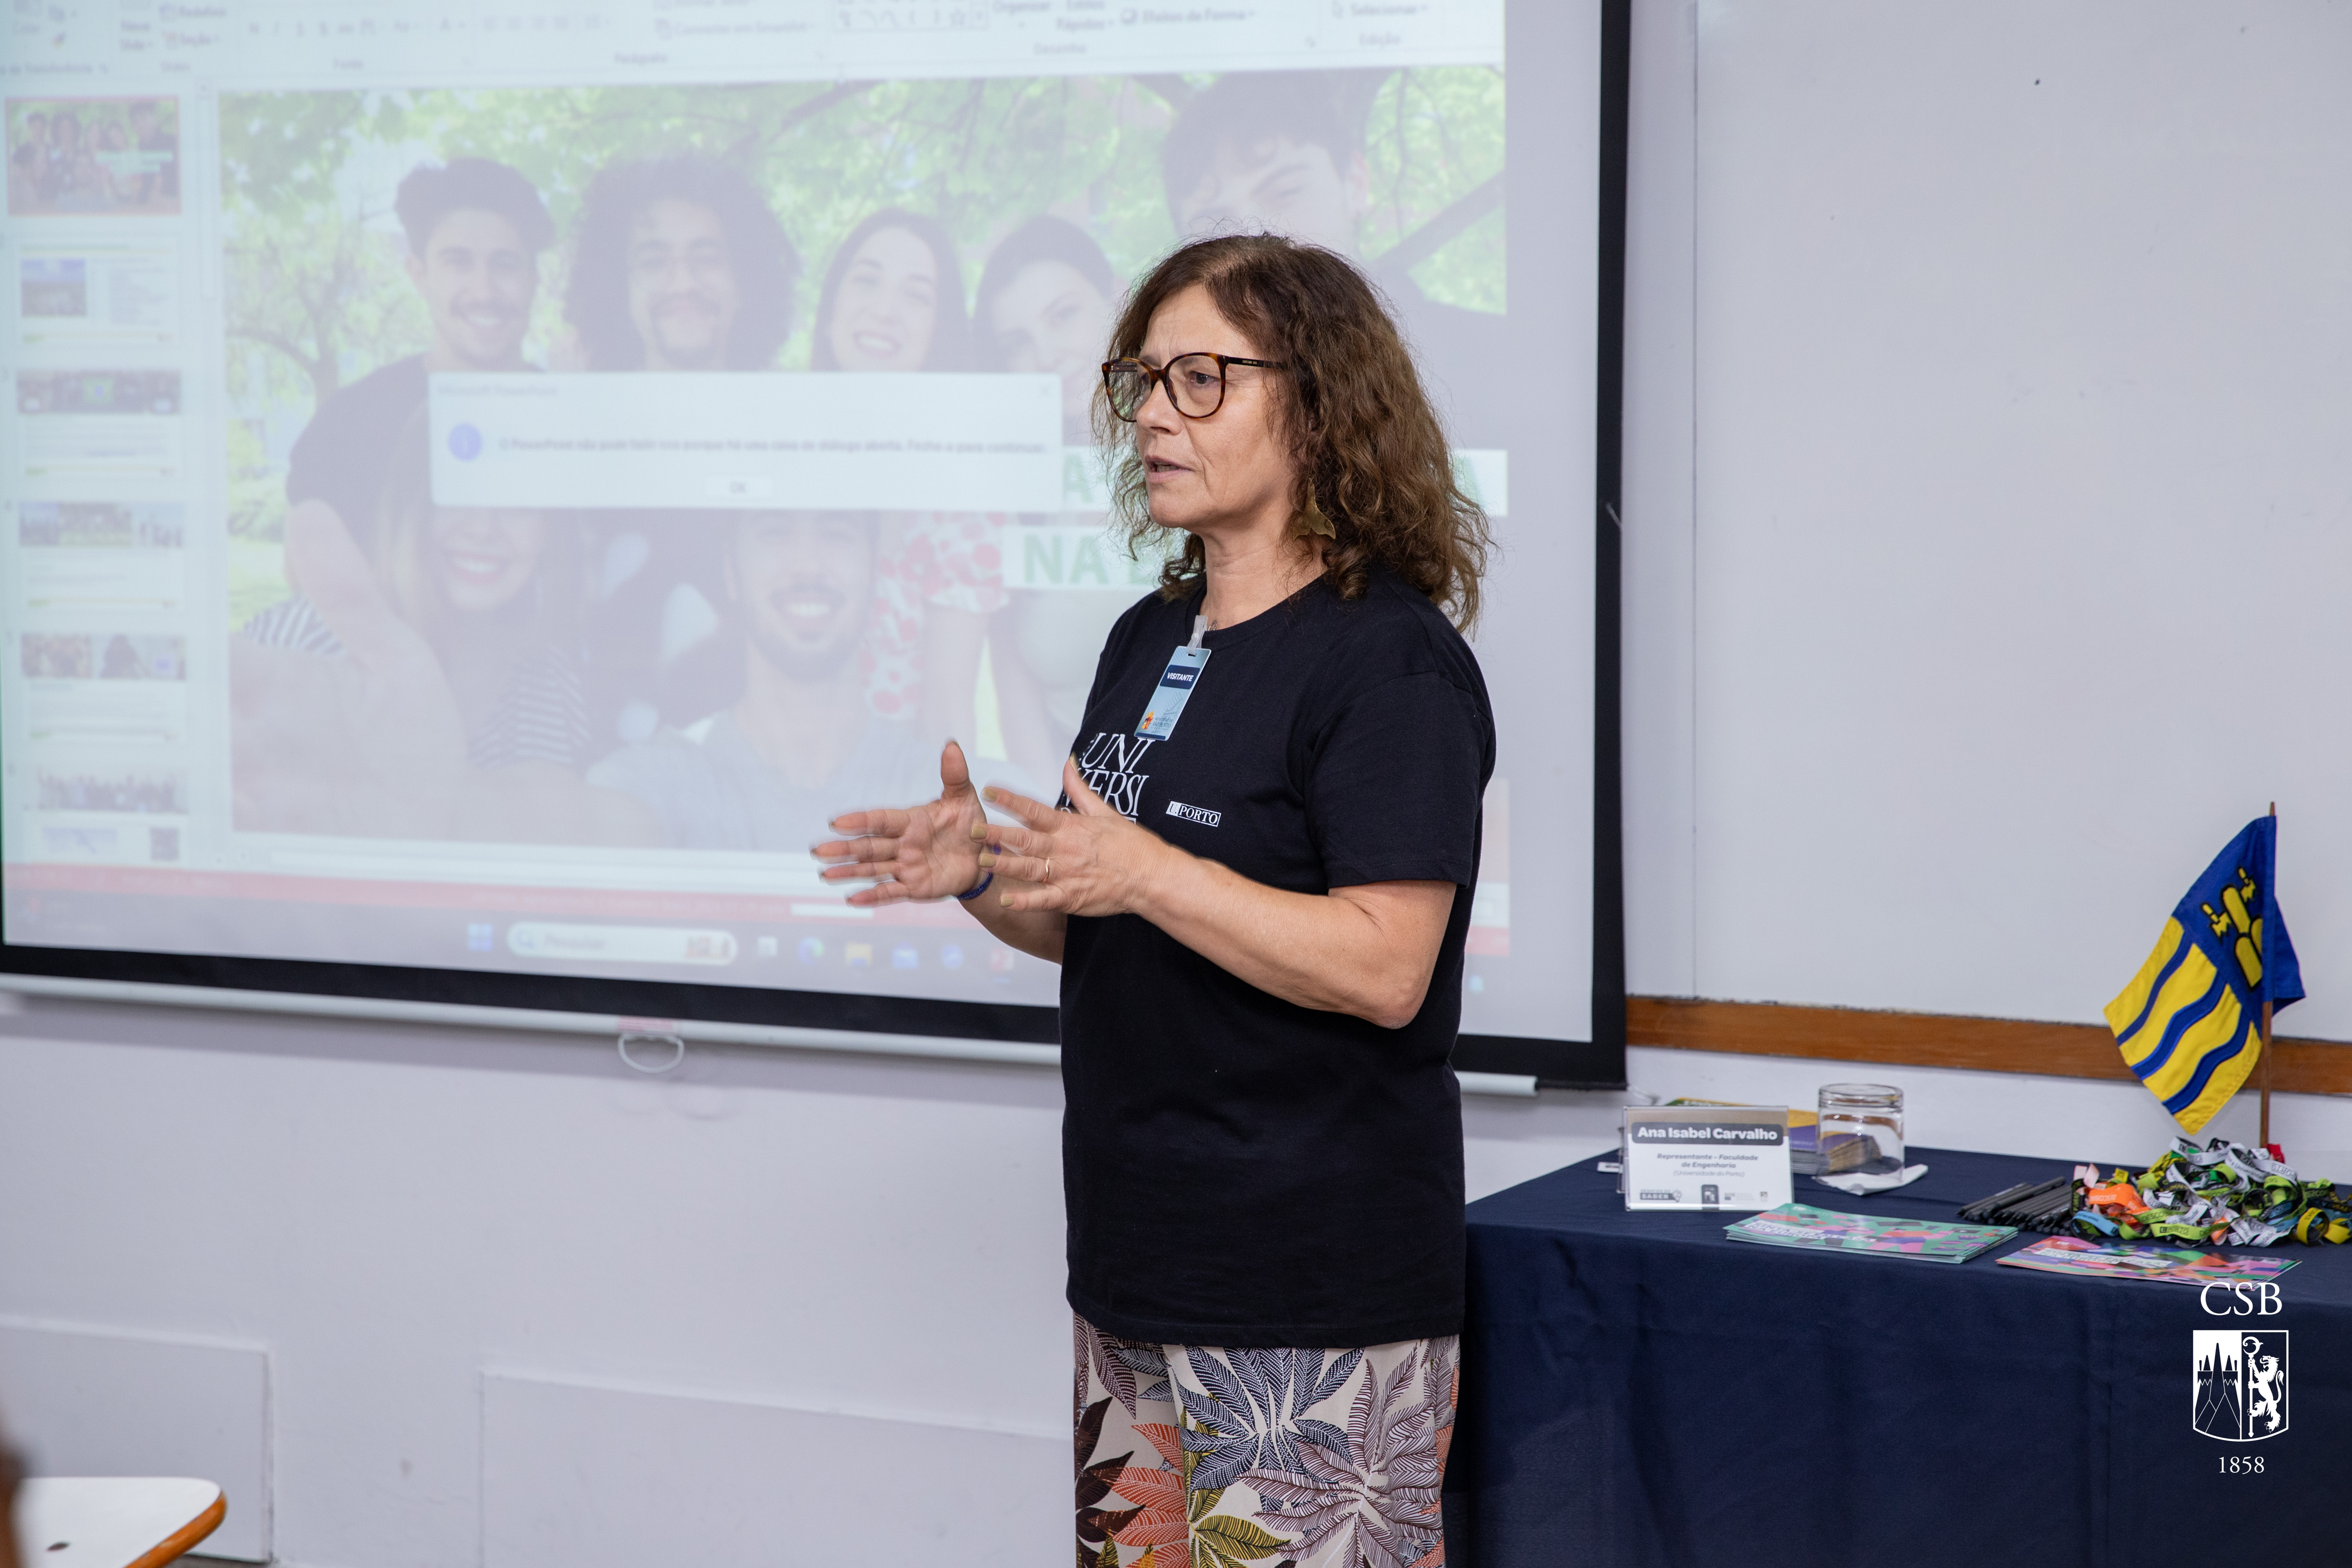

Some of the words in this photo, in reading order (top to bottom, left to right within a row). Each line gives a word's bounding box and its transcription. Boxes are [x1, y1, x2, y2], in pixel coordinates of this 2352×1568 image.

[1167, 672, 1194, 681] VISITANTE
[1081, 732, 1156, 773] UNI
[1638, 1127, 1665, 1138] Ana
[1668, 1127, 1711, 1139] Isabel
[1713, 1128, 1778, 1140] Carvalho
